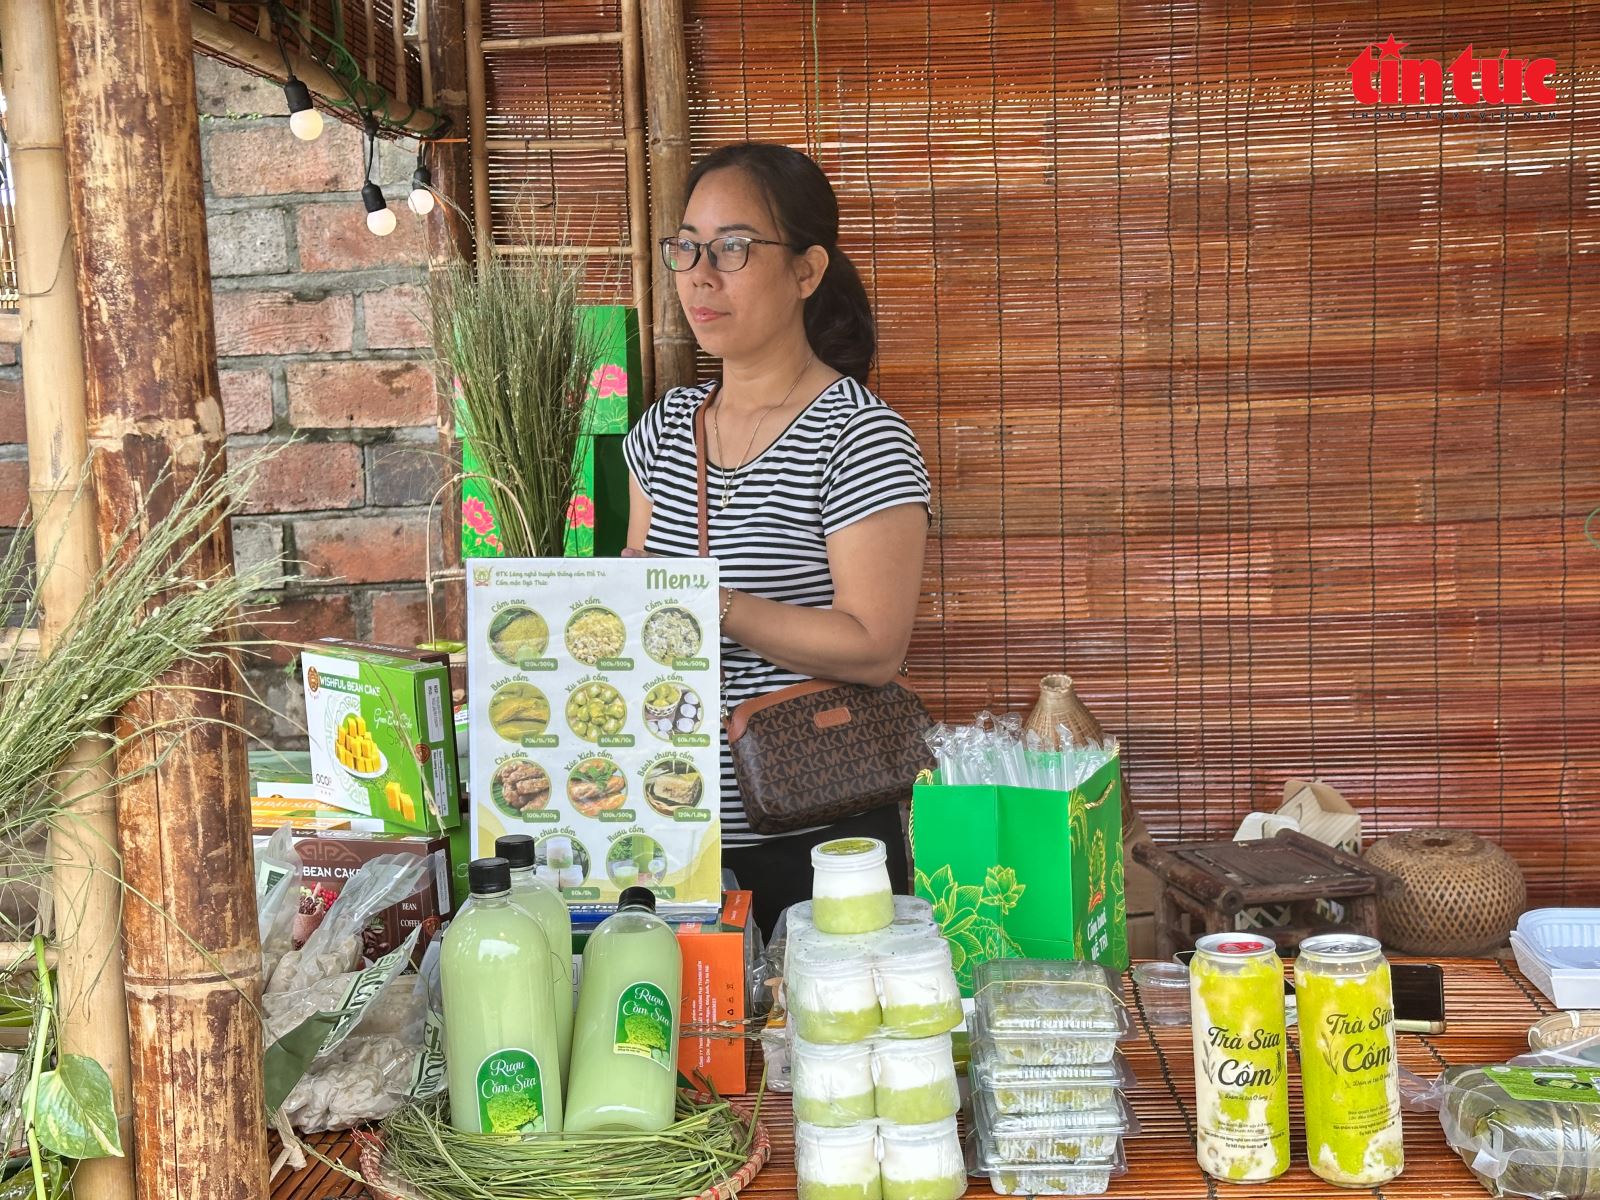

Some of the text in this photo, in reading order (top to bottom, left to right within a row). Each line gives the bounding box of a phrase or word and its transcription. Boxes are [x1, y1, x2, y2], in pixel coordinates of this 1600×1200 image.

[646, 568, 710, 590] Menu
[319, 676, 381, 696] WISHFUL BEAN CAKE
[667, 672, 684, 682] cốm
[628, 825, 646, 834] cốm
[303, 866, 332, 878] BEAN
[401, 902, 417, 911] BEAN
[1326, 1013, 1365, 1036] Trà
[1208, 1026, 1281, 1050] Trà Sữa
[1342, 1042, 1392, 1073] Cốm
[1218, 1059, 1274, 1087] Cốm
